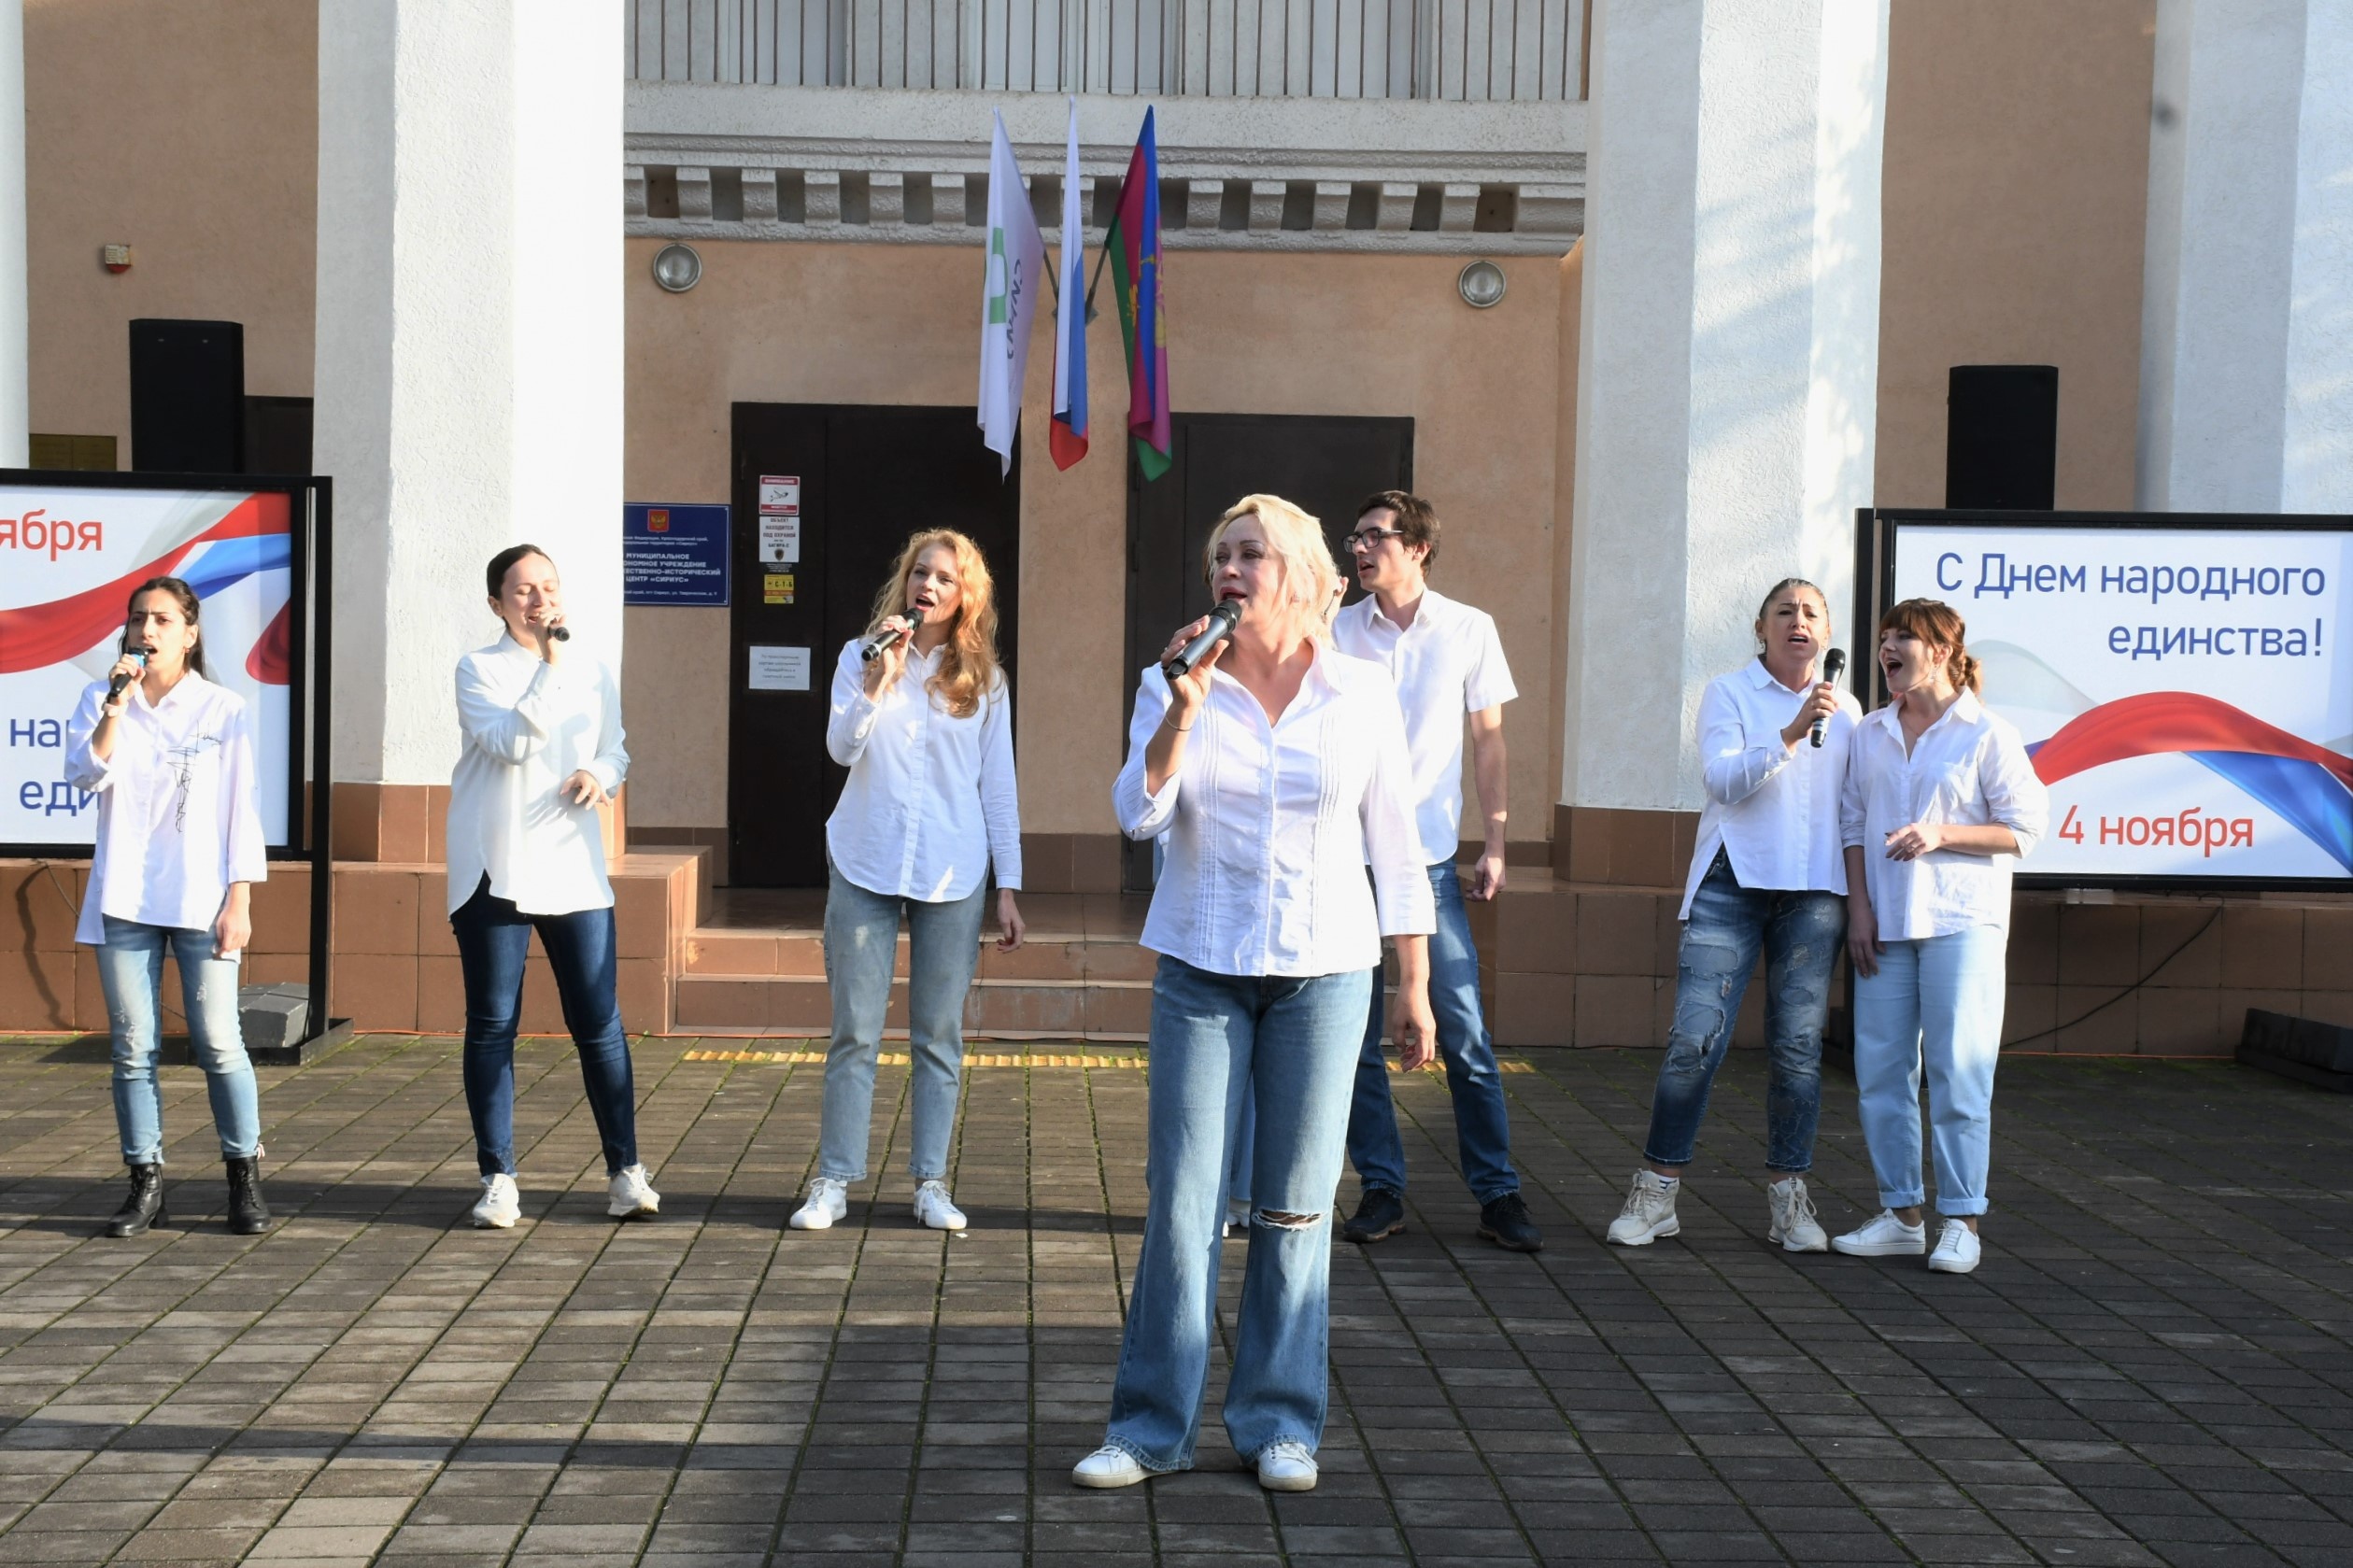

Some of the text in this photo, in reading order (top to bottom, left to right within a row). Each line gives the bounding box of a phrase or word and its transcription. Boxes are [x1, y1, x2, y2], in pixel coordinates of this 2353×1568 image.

[0, 509, 103, 561] ября
[1936, 552, 2326, 605] С Днем народного
[2108, 617, 2322, 661] единства!
[2059, 804, 2253, 858] 4 ноября
